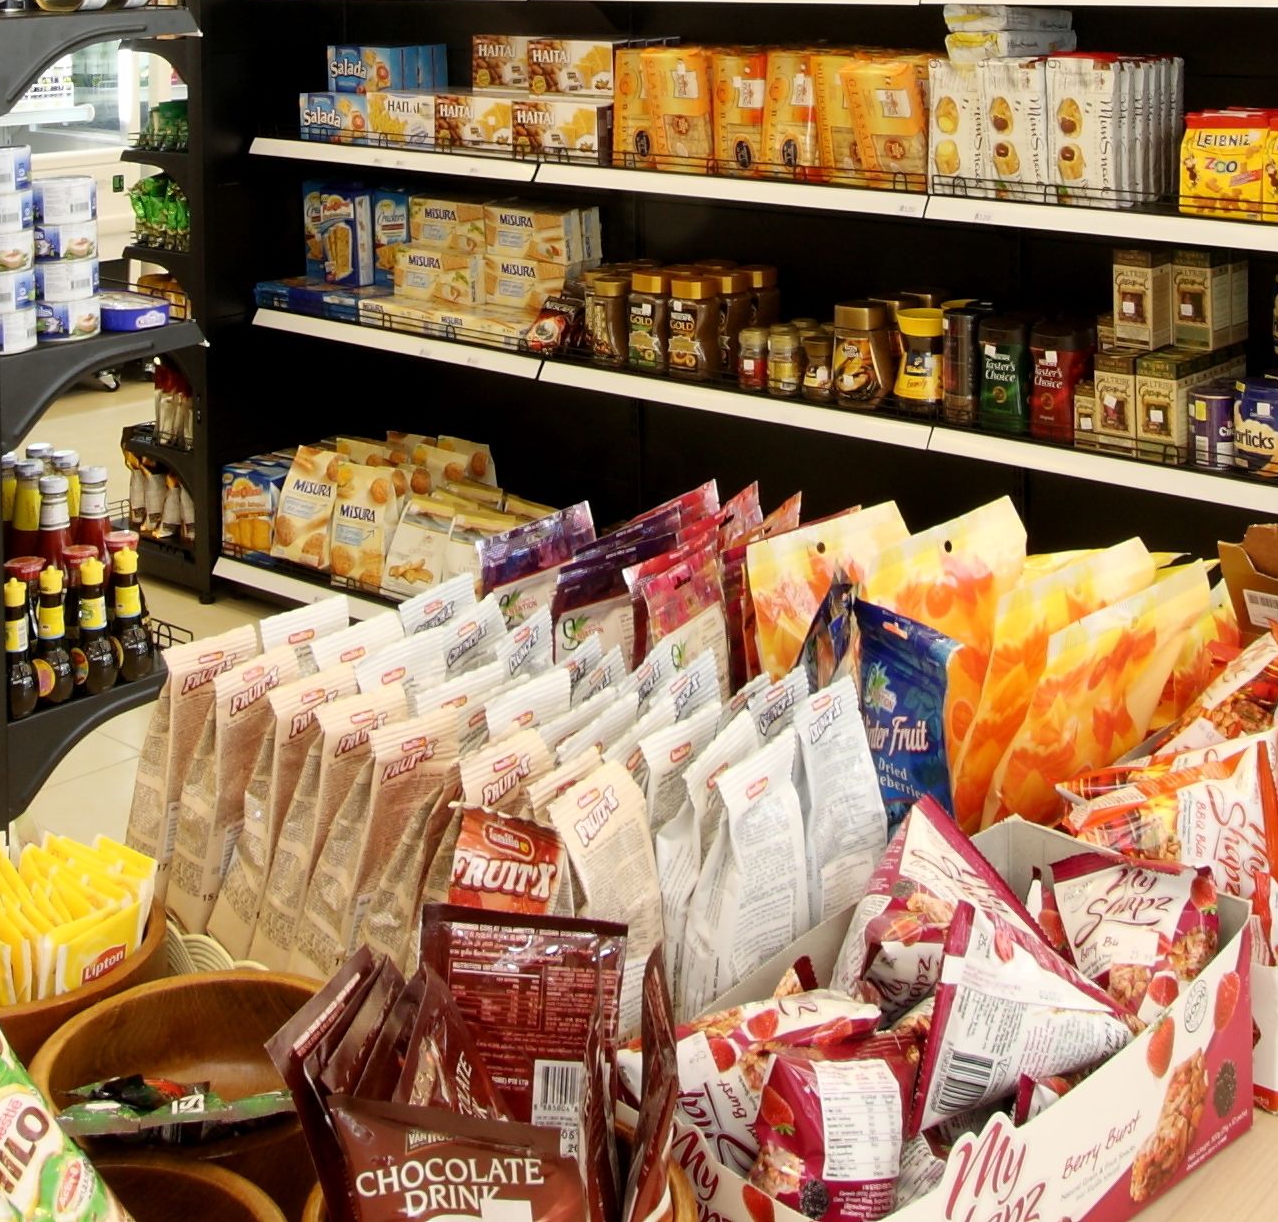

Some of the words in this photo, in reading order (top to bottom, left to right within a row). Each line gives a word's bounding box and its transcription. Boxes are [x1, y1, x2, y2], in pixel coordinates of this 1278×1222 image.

[329, 58, 367, 79] Salada
[303, 108, 341, 128] Salada
[1197, 131, 1251, 147] LEIBNIZ
[629, 315, 653, 325] GOLD
[670, 320, 695, 331] GOLD
[985, 368, 1016, 383] Choice
[1034, 375, 1064, 389] Choice
[889, 716, 929, 757] Fruit
[878, 756, 907, 781] Dried
[84, 949, 125, 981] Lipton
[944, 1121, 1028, 1220] My
[1061, 1144, 1101, 1180] Berry
[355, 1158, 545, 1197] CHOCOLATE
